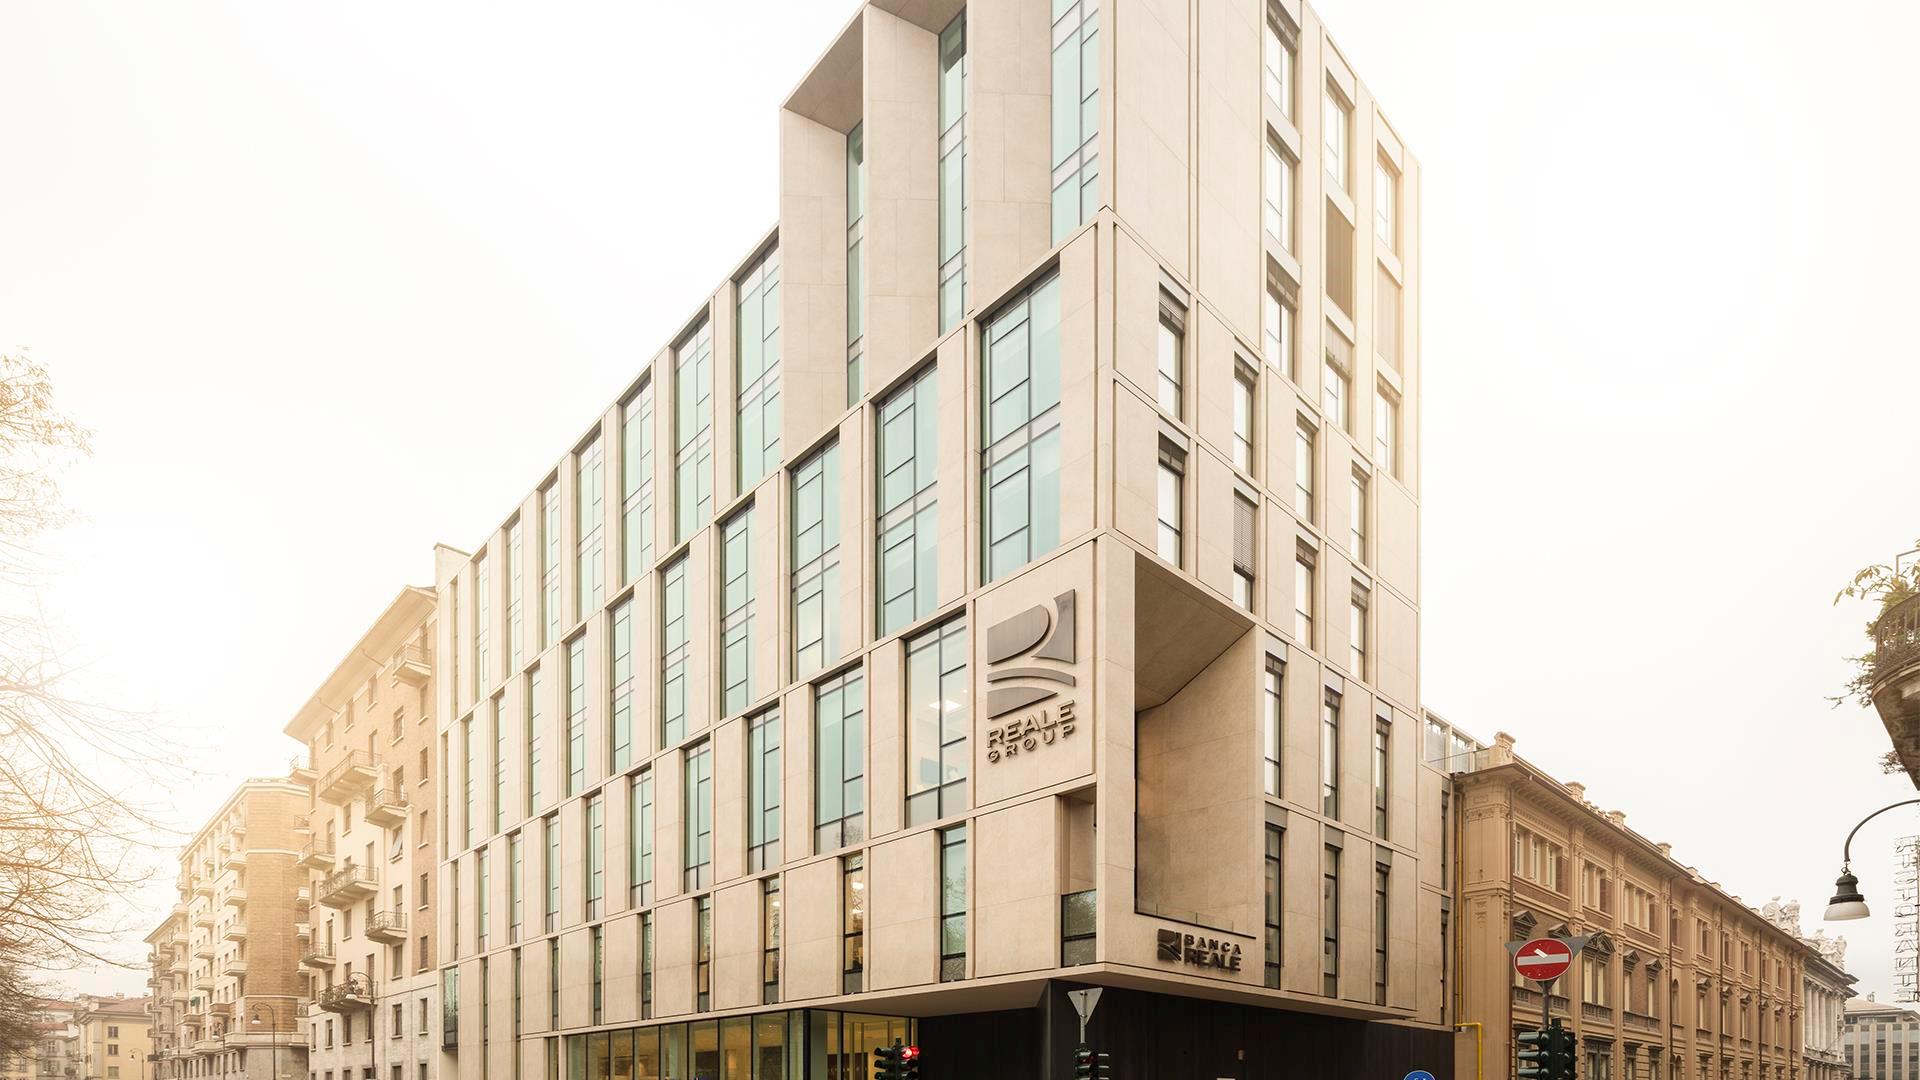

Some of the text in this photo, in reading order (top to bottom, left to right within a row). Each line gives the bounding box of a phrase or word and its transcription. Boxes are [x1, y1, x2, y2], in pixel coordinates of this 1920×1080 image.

[986, 700, 1076, 748] REALE
[987, 723, 1075, 764] GROUP
[1184, 934, 1242, 955] BANCA
[1184, 947, 1242, 972] REALE
